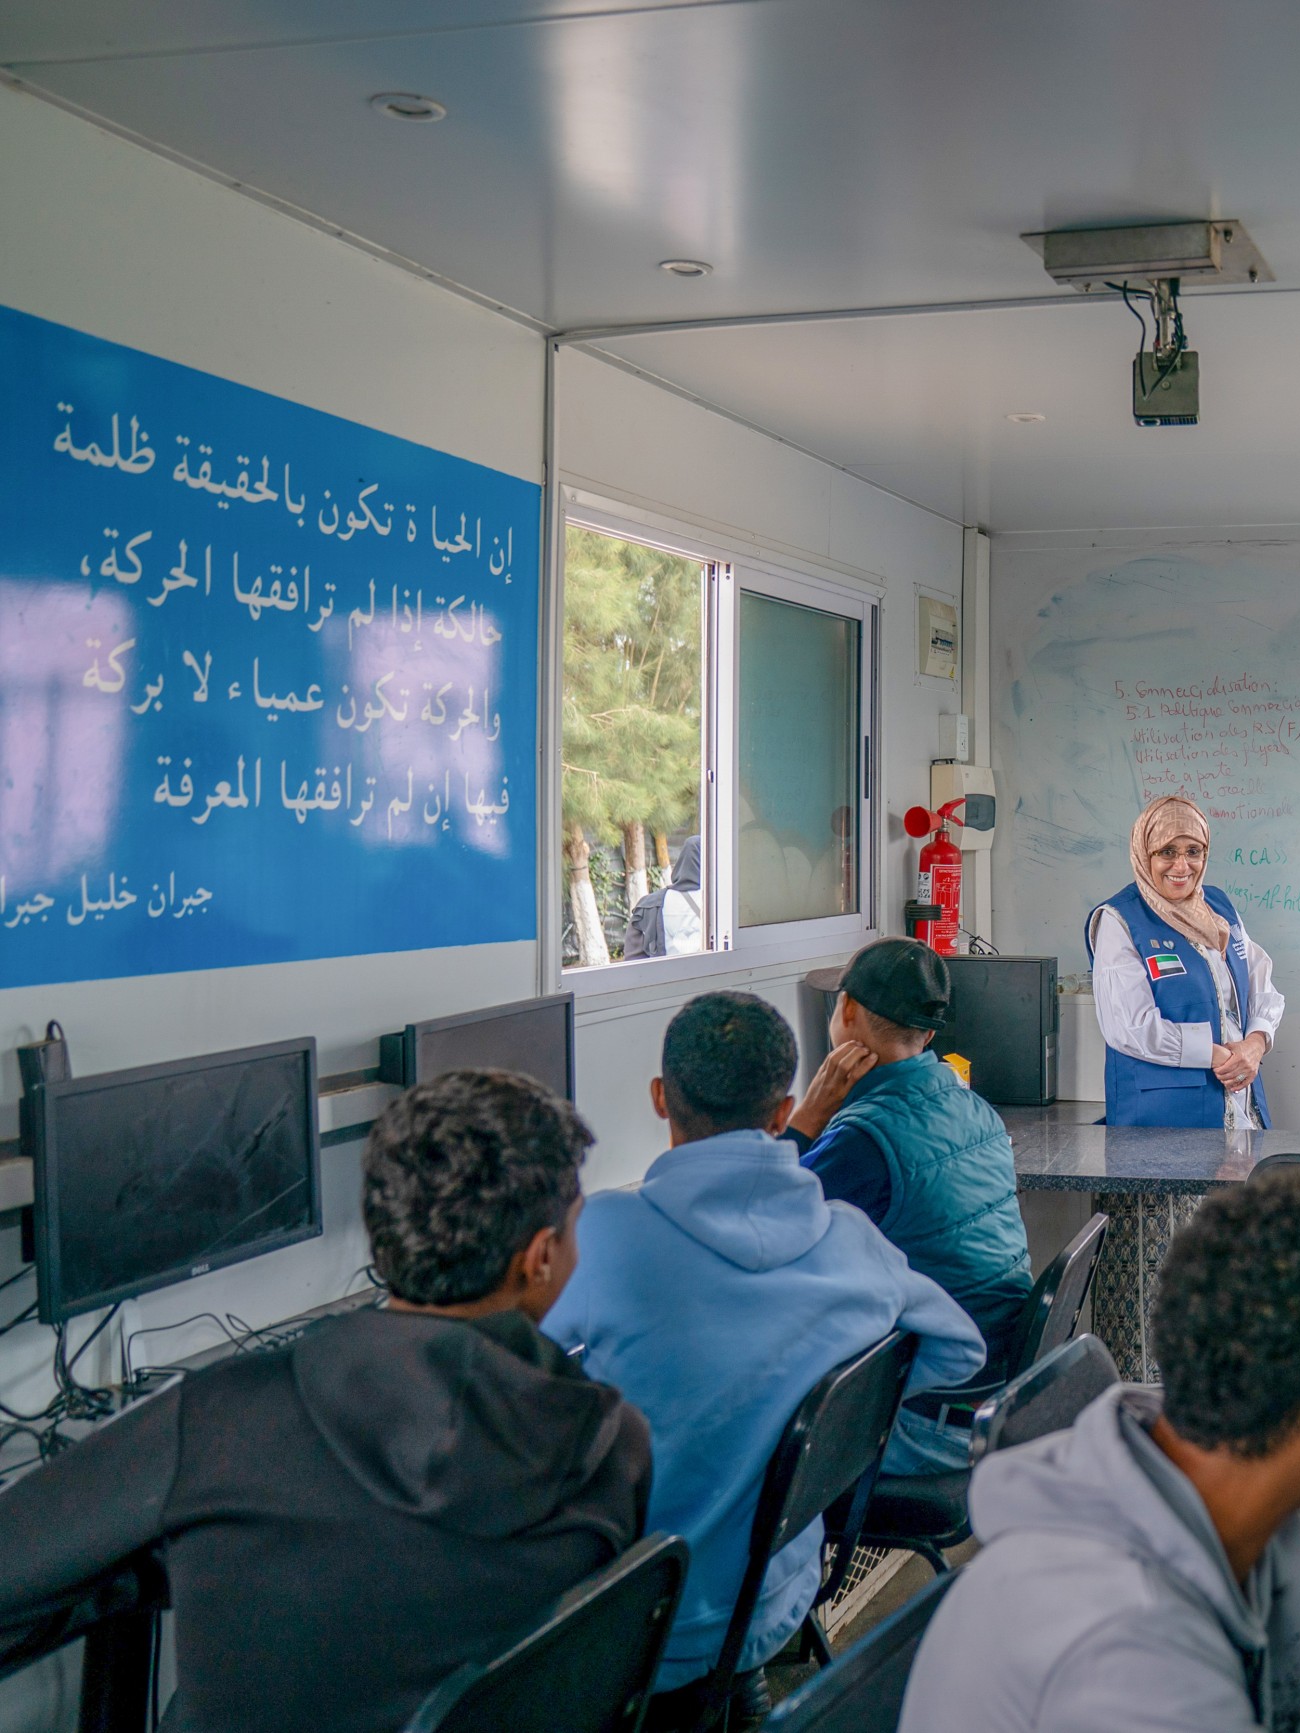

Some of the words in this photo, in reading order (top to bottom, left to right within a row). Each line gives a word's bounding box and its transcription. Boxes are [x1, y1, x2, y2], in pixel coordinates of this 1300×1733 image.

[53, 401, 156, 474] ظلمة
[172, 434, 306, 528] بالحقيقة
[318, 482, 395, 541] تكون
[489, 526, 513, 585] إن
[233, 551, 336, 632] ترافقها
[348, 578, 376, 652] لم
[392, 583, 422, 652] إذا
[433, 594, 502, 646] حالكة
[82, 637, 164, 715] بركة
[182, 650, 213, 703] لا
[228, 656, 325, 722] عمياء
[336, 670, 410, 733] تكون
[420, 681, 501, 741] والحركة
[153, 753, 261, 826] المعرفة
[280, 762, 377, 826] ترافقها
[387, 765, 413, 840] لم
[423, 769, 450, 832] إن
[464, 771, 510, 826] فيها
[66, 872, 138, 926] خليل
[147, 871, 213, 919] جبران
